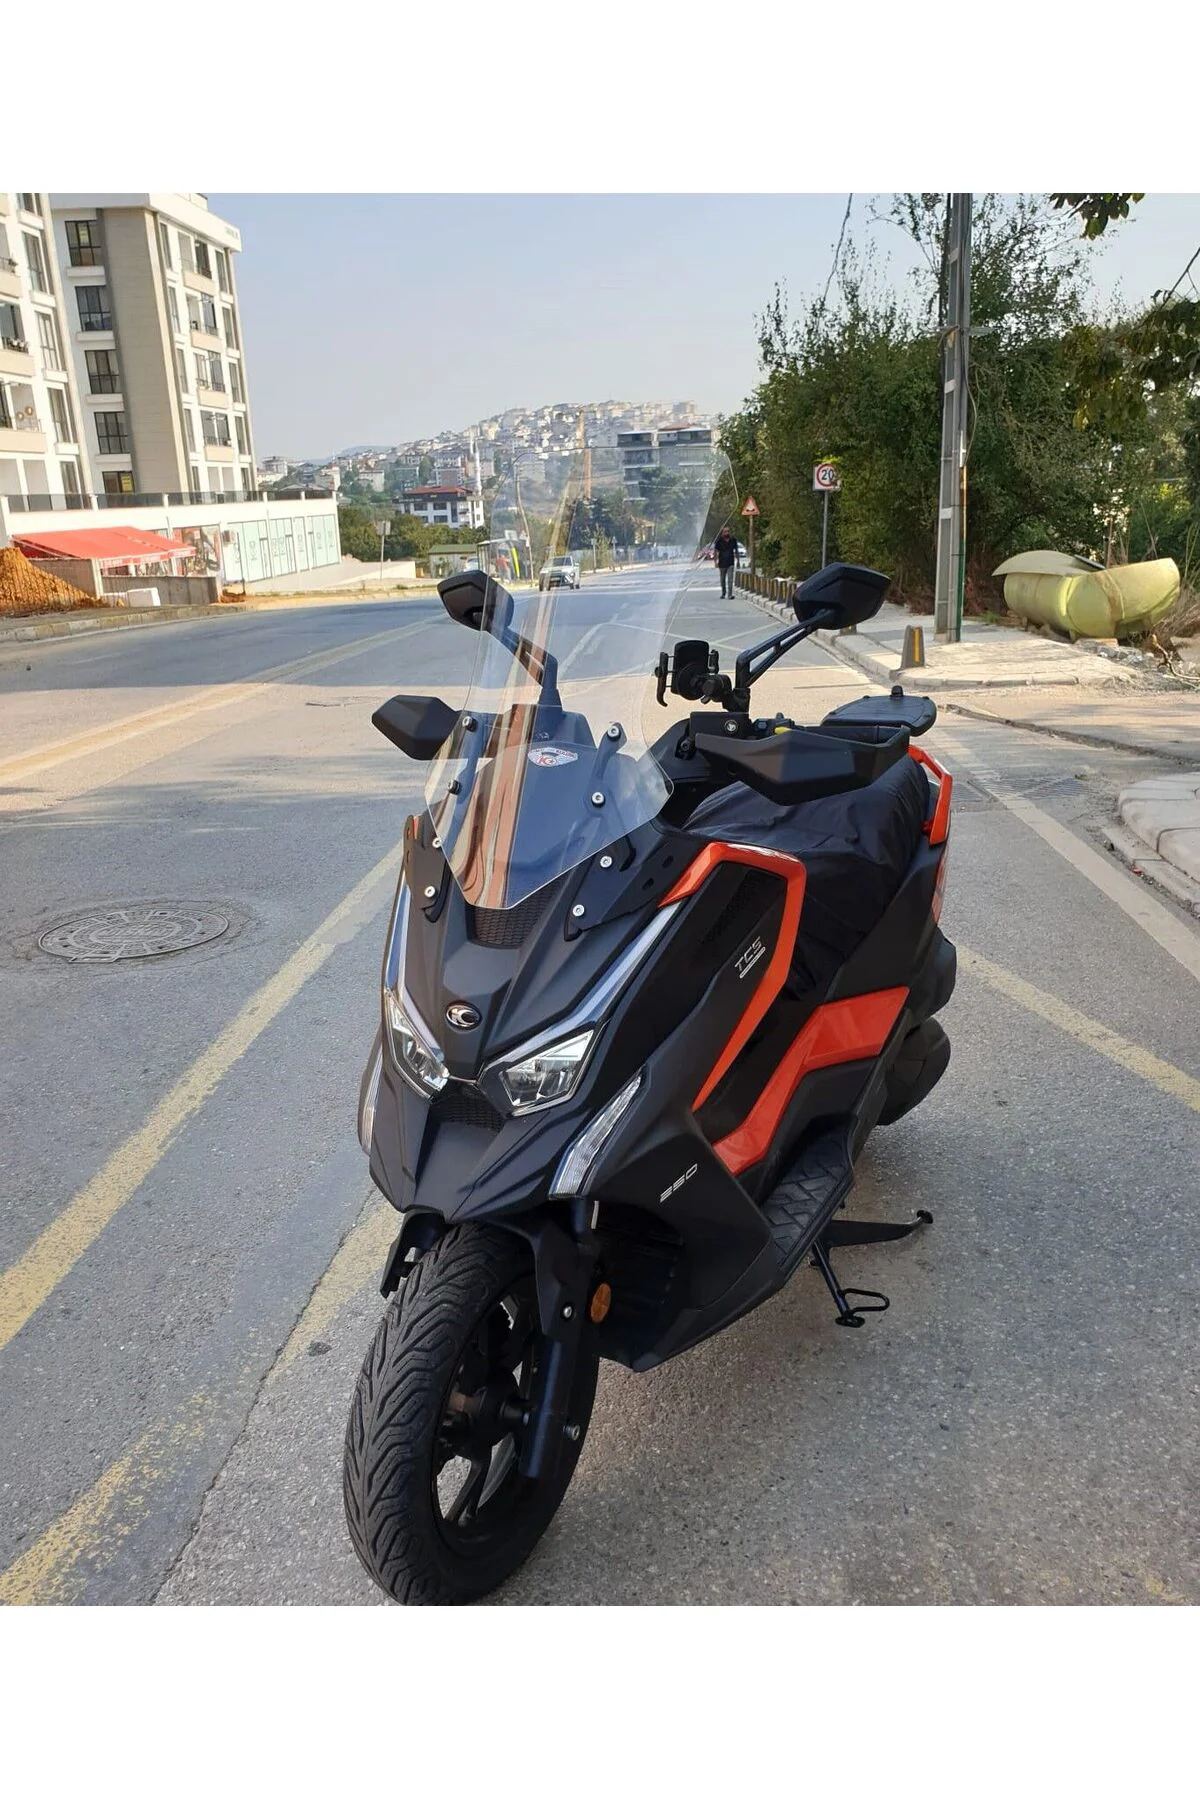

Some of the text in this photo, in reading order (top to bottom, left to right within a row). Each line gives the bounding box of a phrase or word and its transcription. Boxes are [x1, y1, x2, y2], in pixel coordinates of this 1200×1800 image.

[821, 469, 834, 481] 20
[734, 935, 762, 972] TCS
[660, 1163, 698, 1203] 250
